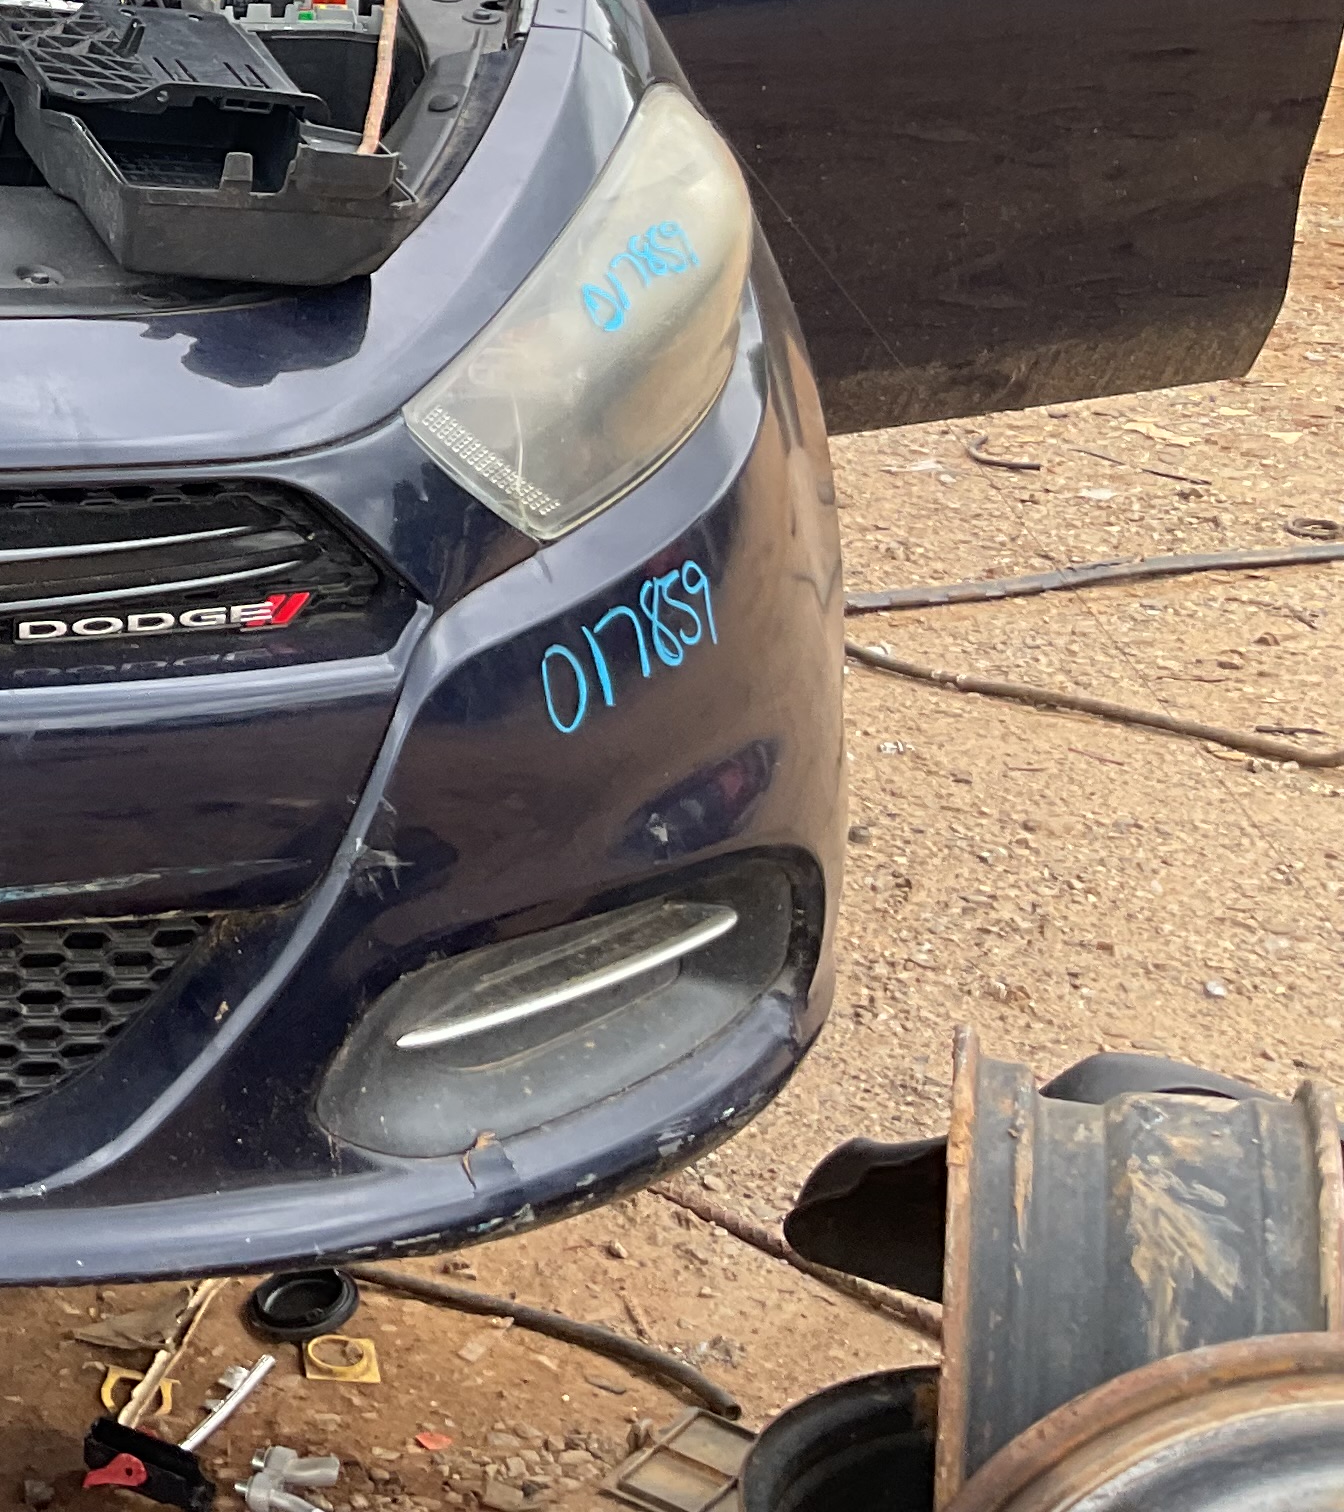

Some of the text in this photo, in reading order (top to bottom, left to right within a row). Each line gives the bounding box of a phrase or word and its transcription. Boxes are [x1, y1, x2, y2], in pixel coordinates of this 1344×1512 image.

[582, 220, 700, 333] 017859
[18, 600, 274, 640] DODGE
[541, 559, 718, 735] 017859
